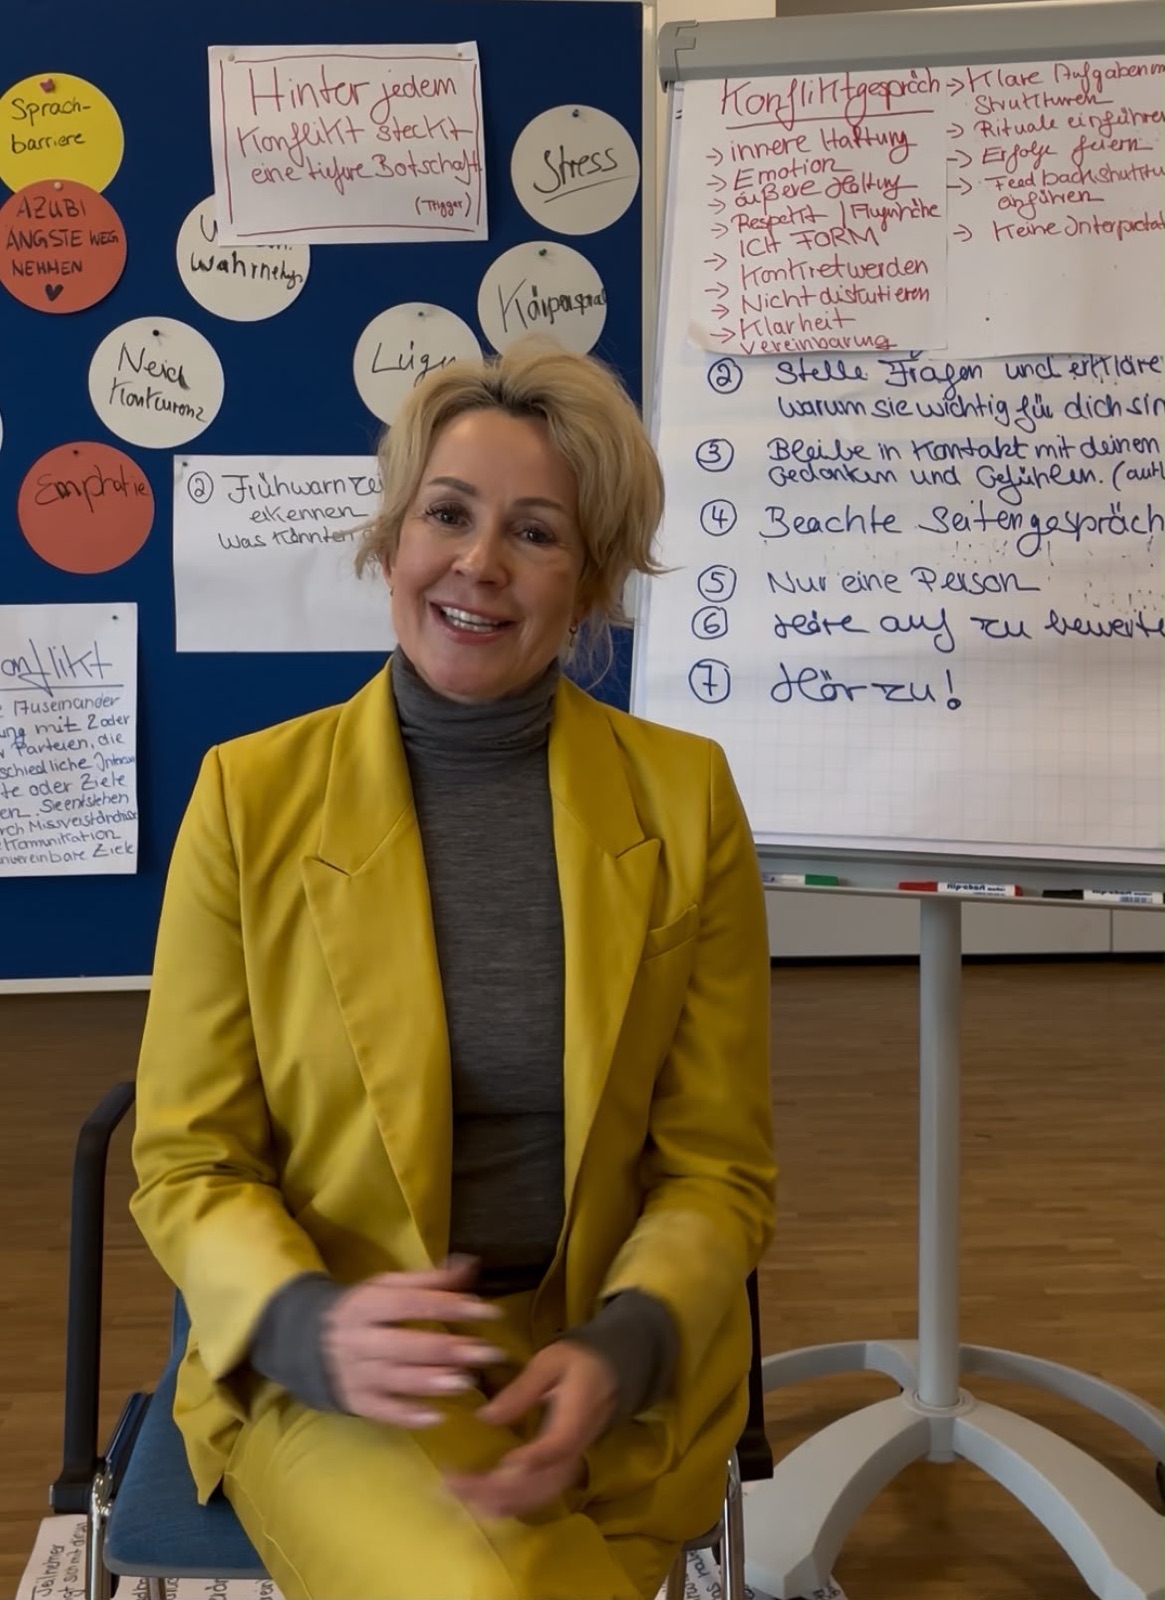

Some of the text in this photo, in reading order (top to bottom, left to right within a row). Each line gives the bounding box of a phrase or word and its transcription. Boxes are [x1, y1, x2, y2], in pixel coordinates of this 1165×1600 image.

[966, 67, 1045, 93] Klare
[249, 64, 457, 125] Hinter jedem
[721, 67, 941, 131] Konfliktgespräch
[11, 98, 92, 127] Sprach-
[973, 114, 1059, 138] Rituale
[11, 132, 86, 154] barriere
[237, 115, 473, 168] Konflikt steckt
[730, 126, 918, 164] innere Haltung
[982, 135, 1154, 174] Erfolge feiern
[251, 163, 302, 185] eine
[533, 145, 619, 193] Stress
[734, 157, 852, 190] Emotion
[17, 196, 87, 219] AZUBI
[415, 192, 472, 217] (Trigger)
[731, 204, 829, 240] Respekt
[993, 220, 1062, 242] Keine
[89, 230, 119, 246] WEG
[739, 226, 879, 258] ICH FORM
[846, 257, 929, 279] werden
[742, 285, 817, 315] Nicht
[739, 307, 856, 340] Klarheit
[775, 359, 868, 385] Stelle
[879, 359, 983, 400] Fragen
[1005, 356, 1061, 381] und
[1069, 355, 1162, 379] erkläre
[778, 397, 866, 419] warum
[870, 397, 914, 418] sie
[916, 393, 1010, 426] wichtig
[1014, 393, 1054, 433] für
[1064, 392, 1122, 420] dich
[767, 438, 870, 462] Bleibe
[878, 439, 900, 460] in
[912, 437, 1028, 461] Kontakt
[1033, 434, 1076, 460] mit
[911, 464, 961, 486] und
[249, 506, 369, 523] erkennen
[760, 504, 901, 538] Beachte
[218, 533, 267, 549] Was
[768, 571, 826, 595] Nur
[842, 572, 901, 594] eine
[912, 567, 1040, 595] Person
[880, 609, 955, 653] auf
[970, 617, 1032, 640] zu
[36, 716, 82, 734] mit
[87, 713, 99, 731] 2
[100, 713, 131, 727] oder
[98, 732, 125, 746] die
[29, 780, 73, 796] oder
[80, 772, 127, 791] Ziele
